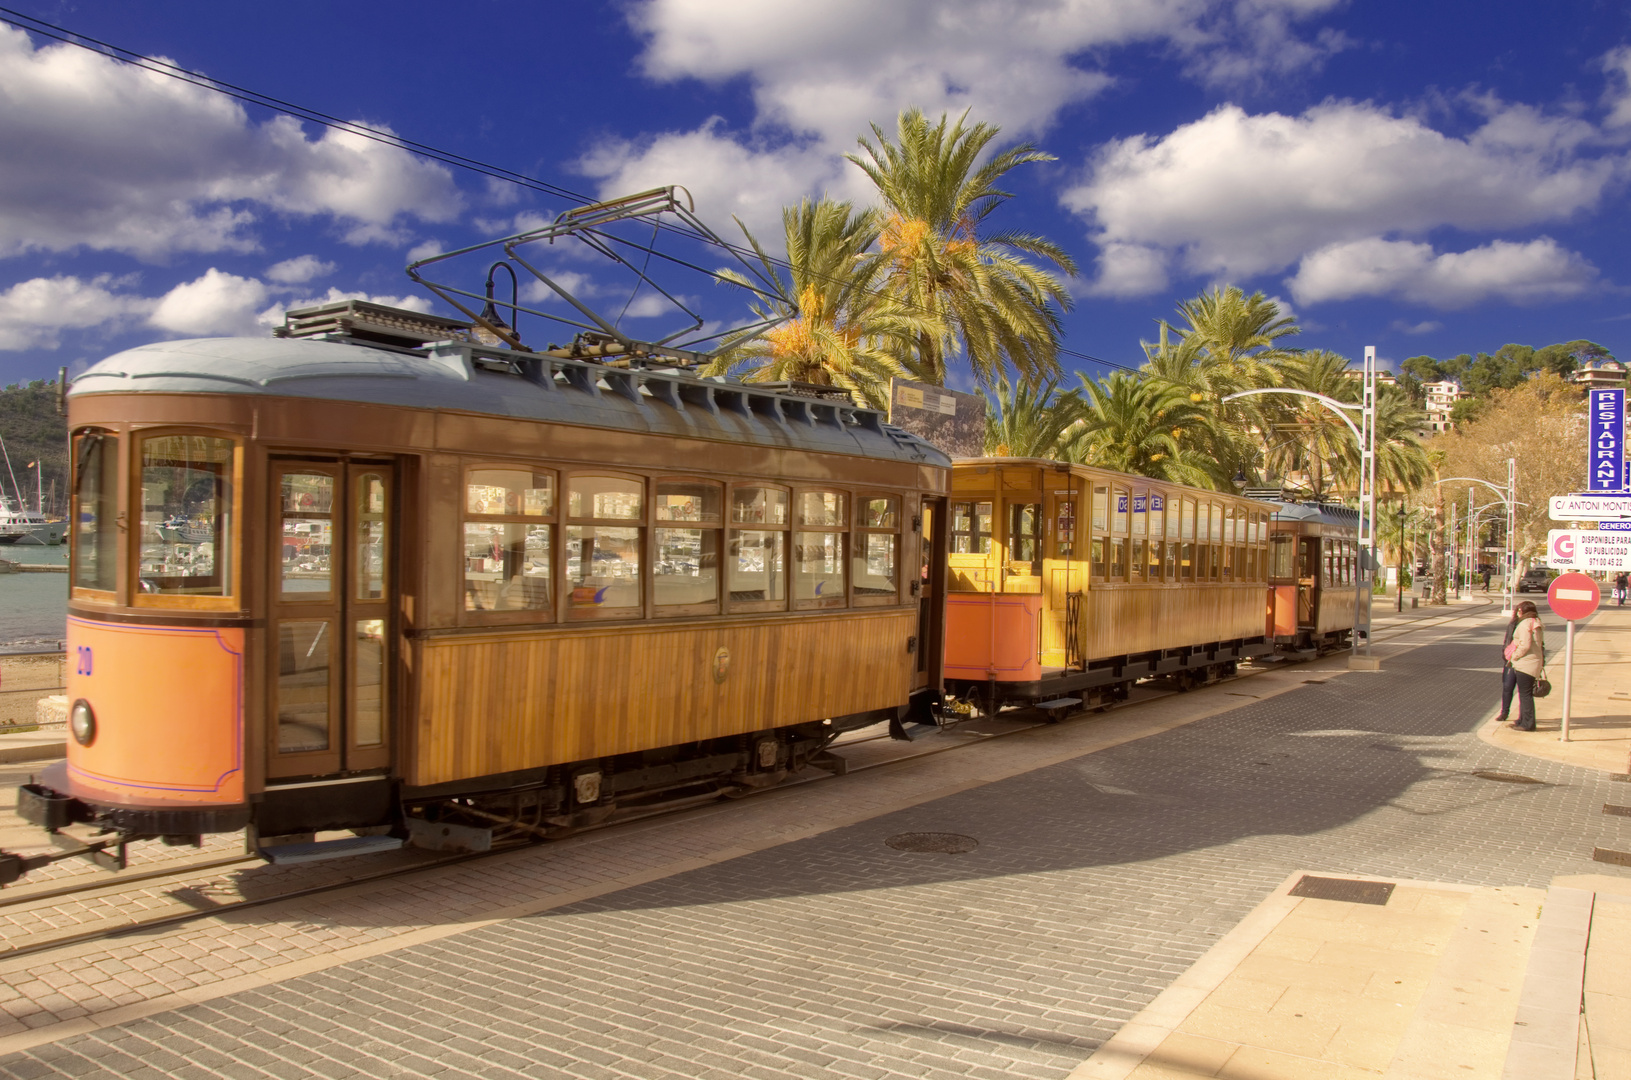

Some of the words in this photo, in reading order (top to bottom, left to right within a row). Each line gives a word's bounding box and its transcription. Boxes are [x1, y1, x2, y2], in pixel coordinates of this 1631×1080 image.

[1597, 392, 1616, 488] RESTAURANT
[1568, 501, 1599, 510] ANTONI
[1581, 536, 1615, 544] DISPONIBLE
[1616, 536, 1631, 545] PARA
[1585, 547, 1592, 555] SU
[1594, 547, 1627, 555] PUBLICIDAD
[77, 646, 92, 676] 20
